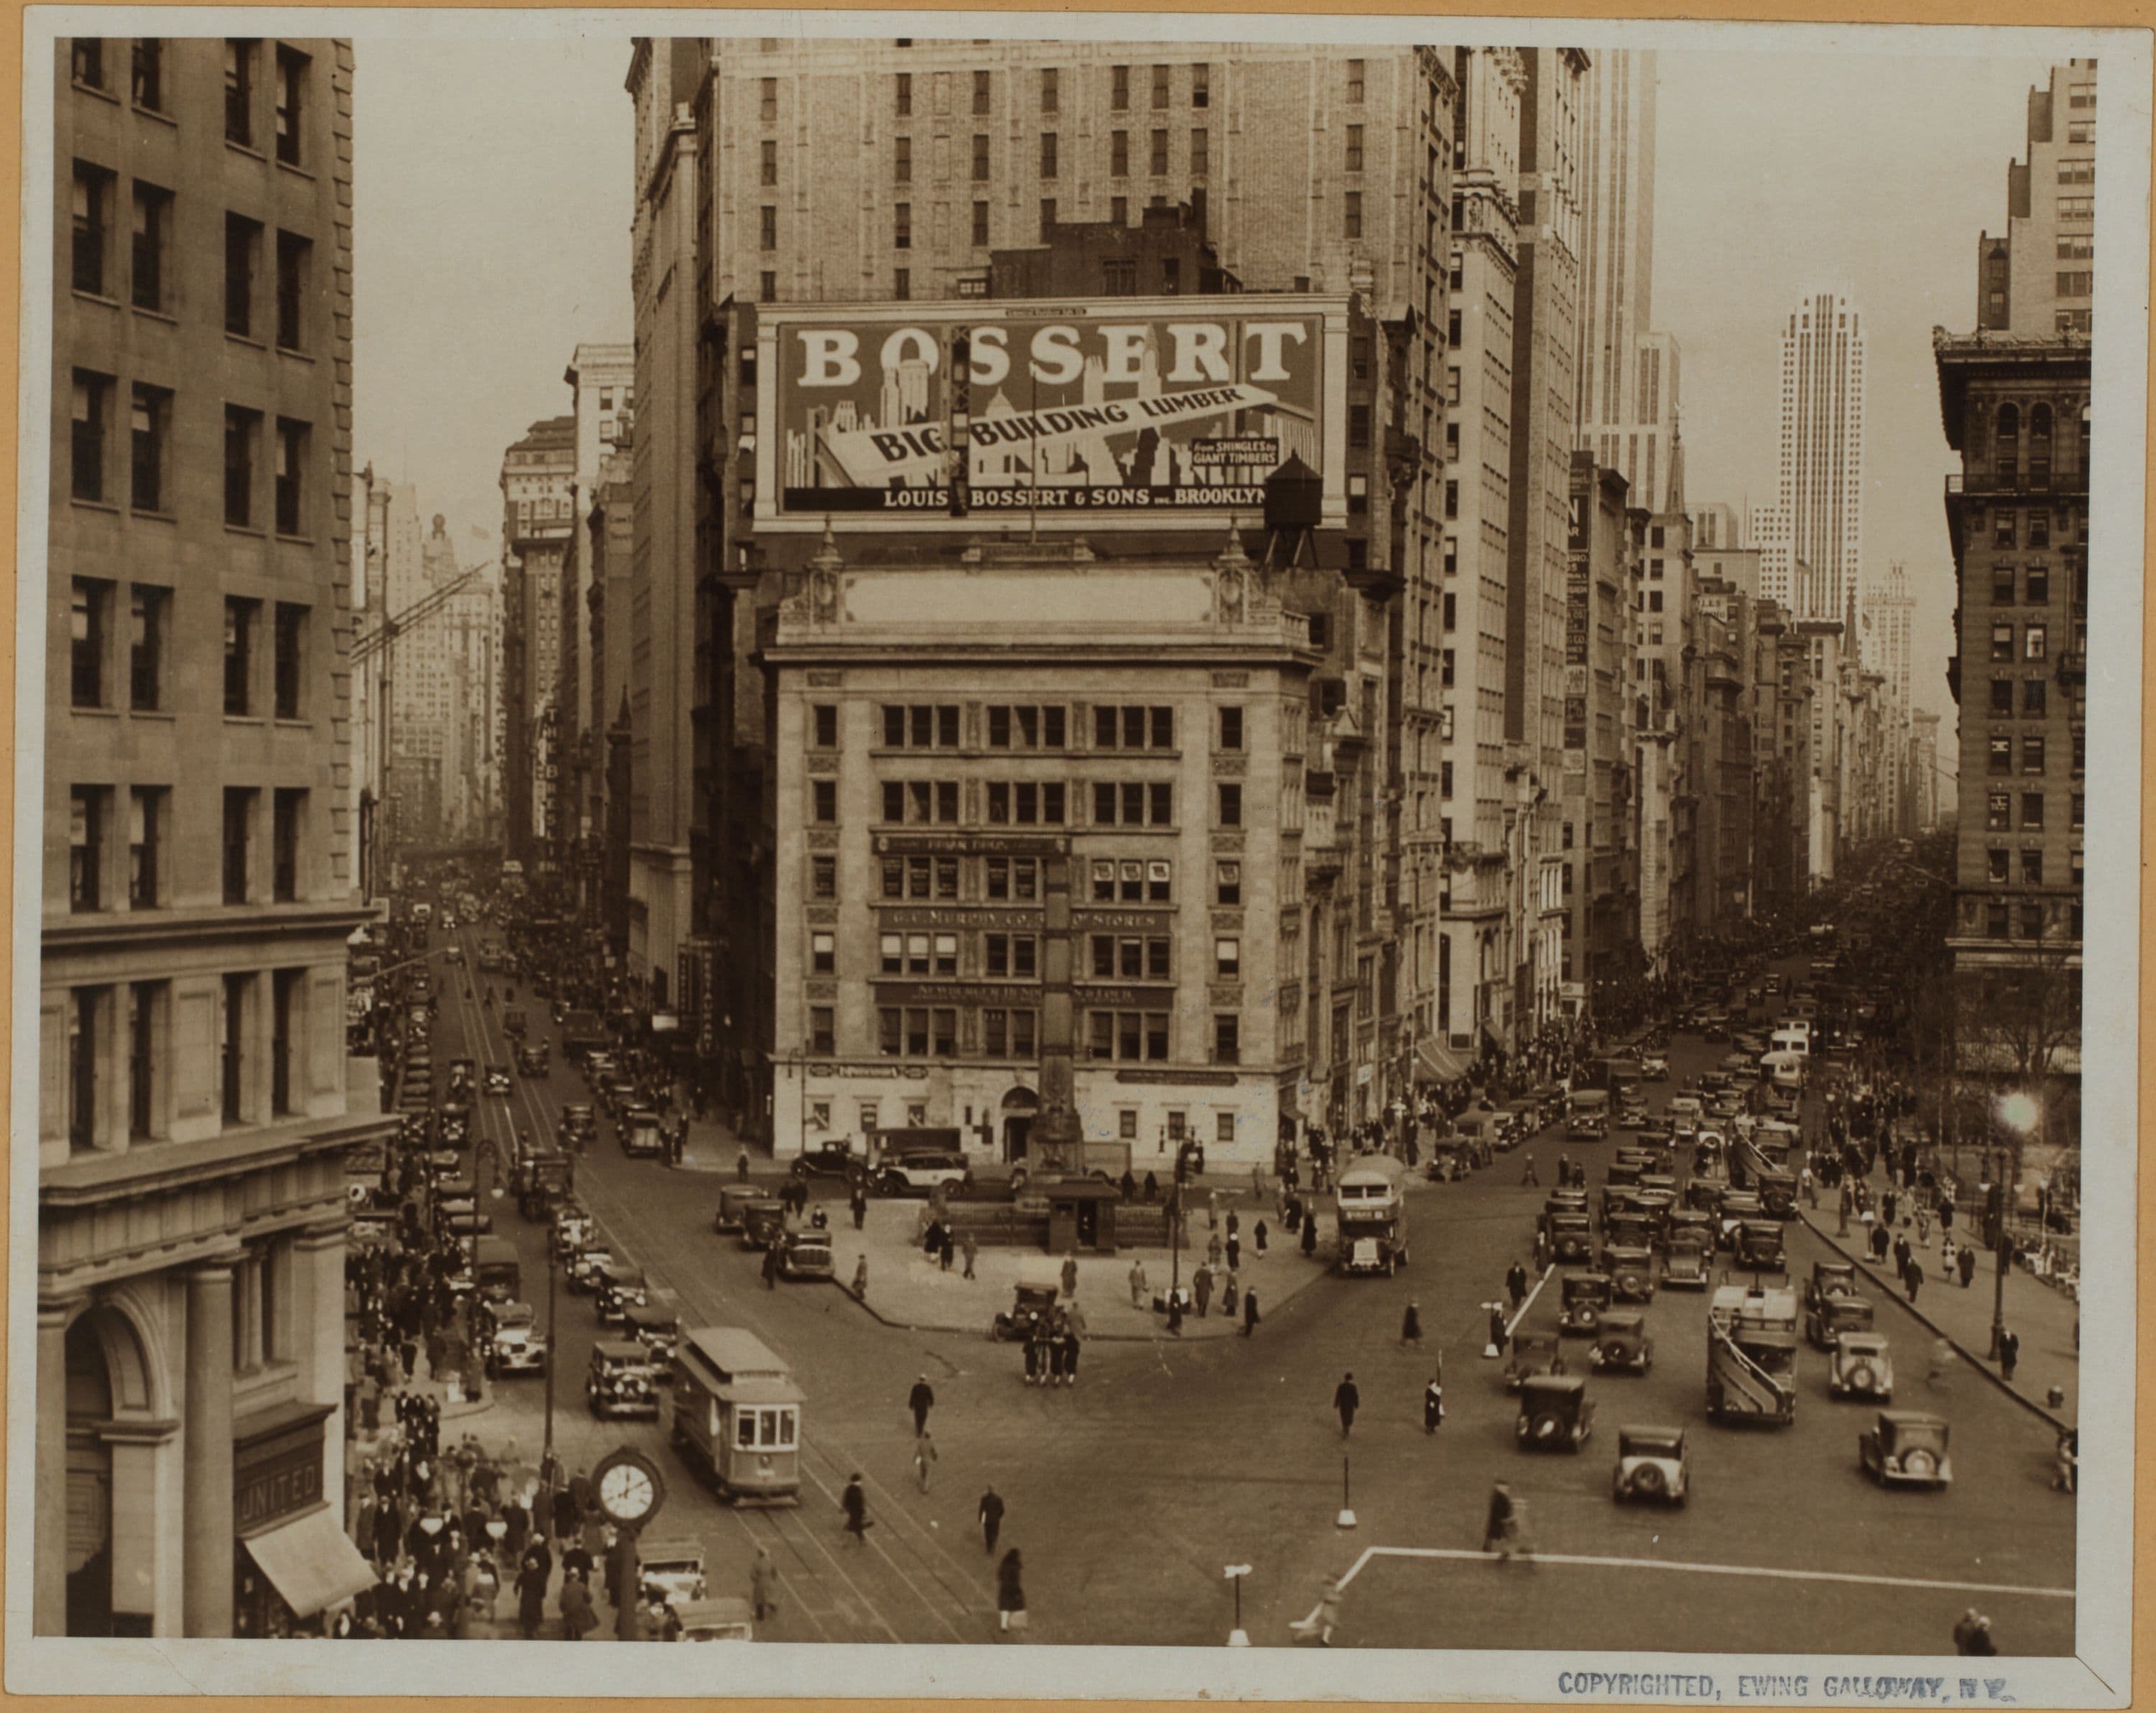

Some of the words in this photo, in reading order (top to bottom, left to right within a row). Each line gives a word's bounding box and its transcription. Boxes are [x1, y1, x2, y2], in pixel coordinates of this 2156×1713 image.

[797, 323, 1307, 387] BOSSERT
[871, 428, 947, 463] BIG
[970, 403, 1129, 447] BUILDING
[1139, 388, 1245, 417] LUMBER
[1216, 440, 1266, 452] SHINGLES
[1193, 453, 1227, 464] GIANT
[1229, 452, 1276, 464] TIMBERS
[884, 490, 948, 507] LOUIS
[971, 489, 1069, 506] BOSSERT
[1074, 491, 1086, 504] &
[1091, 488, 1149, 504] SONS
[1175, 487, 1266, 504] BROOKLYN
[545, 764, 558, 872] BRESLIN
[242, 1466, 315, 1520] UNITED
